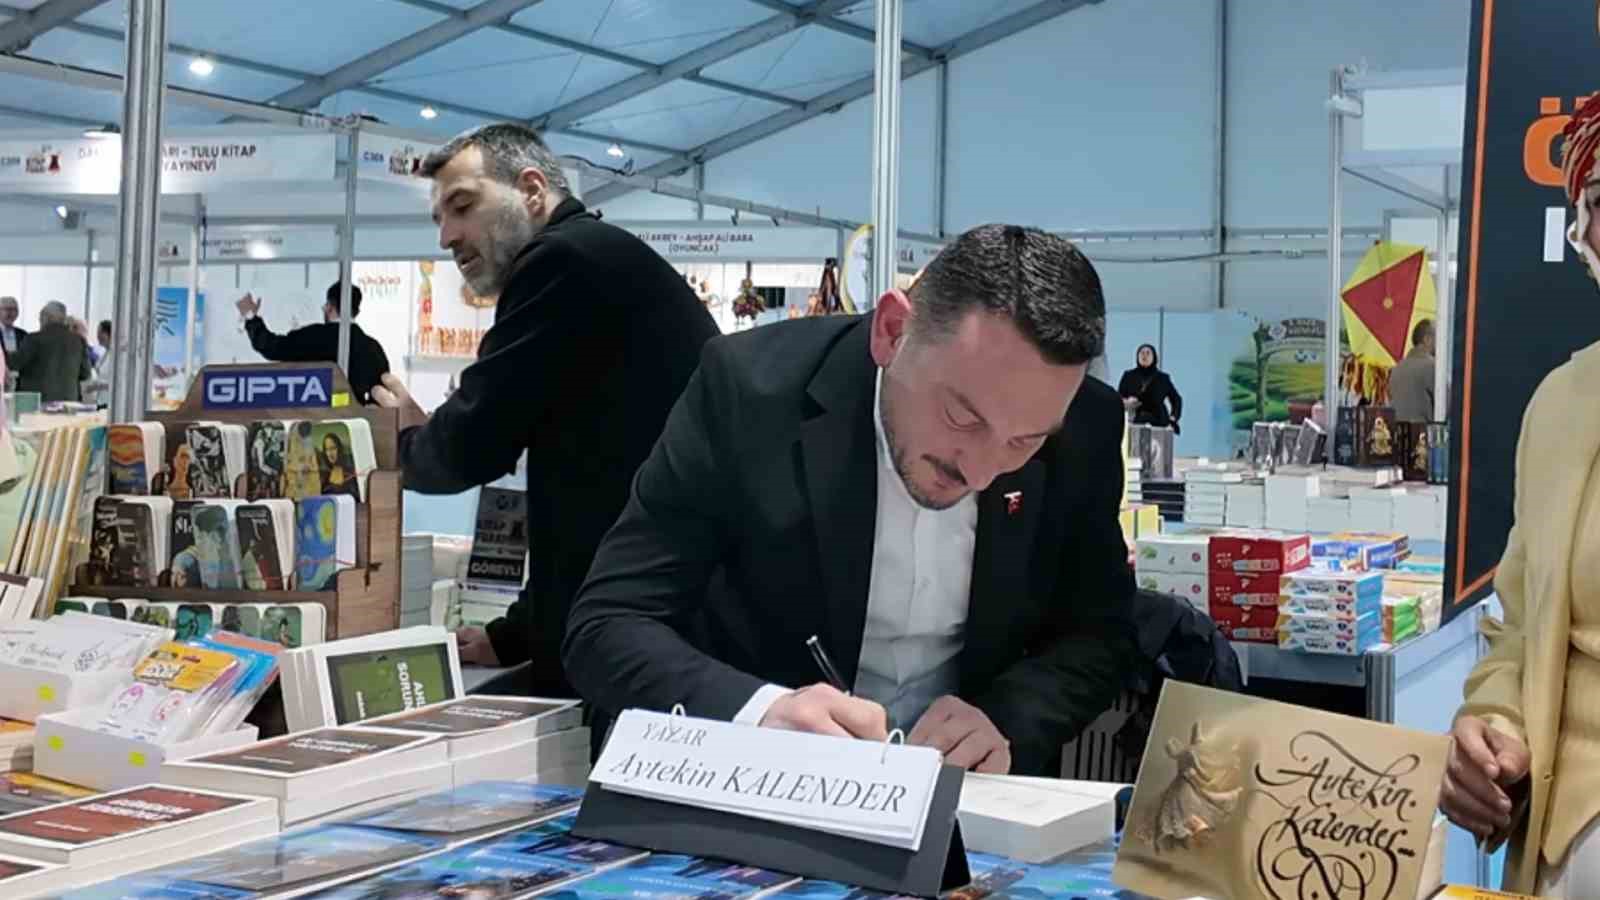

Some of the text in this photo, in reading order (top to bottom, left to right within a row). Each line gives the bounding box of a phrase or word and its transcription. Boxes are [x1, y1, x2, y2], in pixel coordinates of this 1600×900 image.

[192, 145, 219, 158] TULU
[221, 143, 256, 157] KİTAP
[207, 375, 328, 403] GIPTA
[471, 560, 521, 577] GÖREVLİ
[641, 722, 707, 746] YAZAR
[608, 752, 908, 814] Aytekin KALENDER
